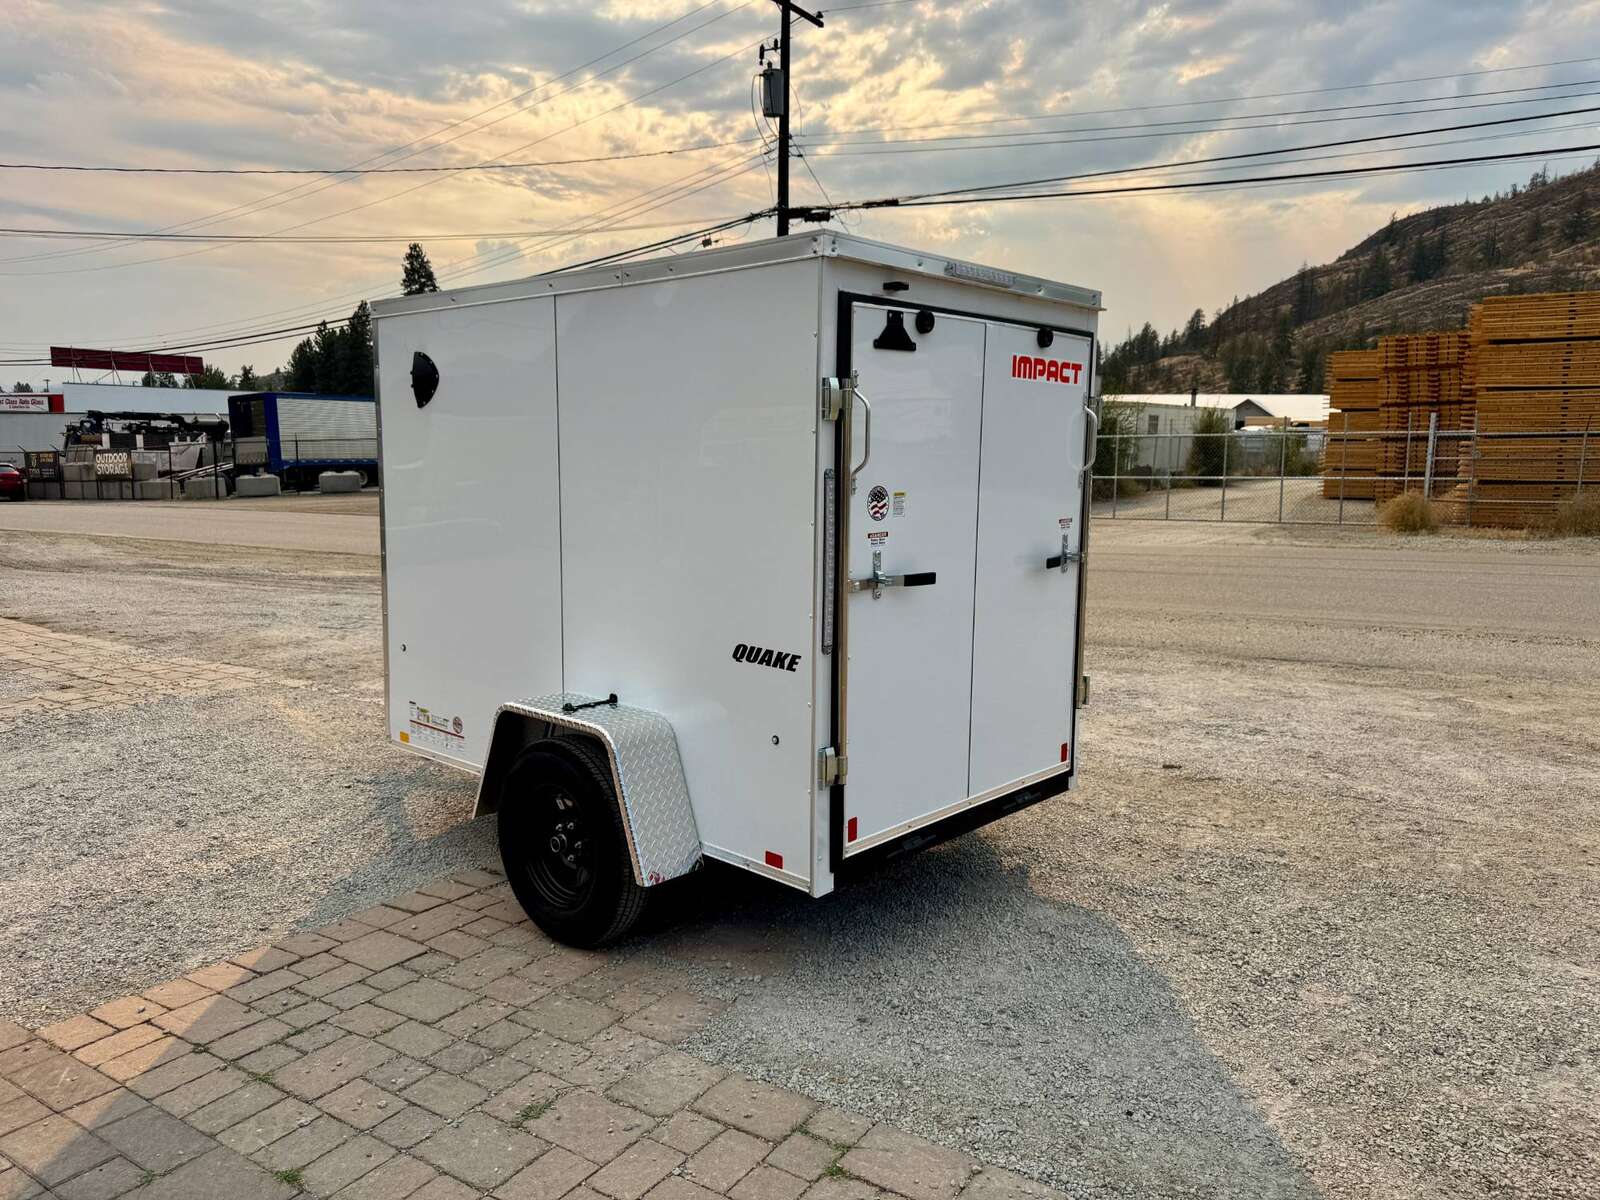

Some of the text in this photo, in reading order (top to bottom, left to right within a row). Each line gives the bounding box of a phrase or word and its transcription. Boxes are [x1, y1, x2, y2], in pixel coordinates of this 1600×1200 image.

[1012, 355, 1082, 384] IMPACT
[95, 453, 128, 463] OUTDOOR
[96, 464, 129, 475] STORAGE
[732, 643, 802, 672] QUAKE
